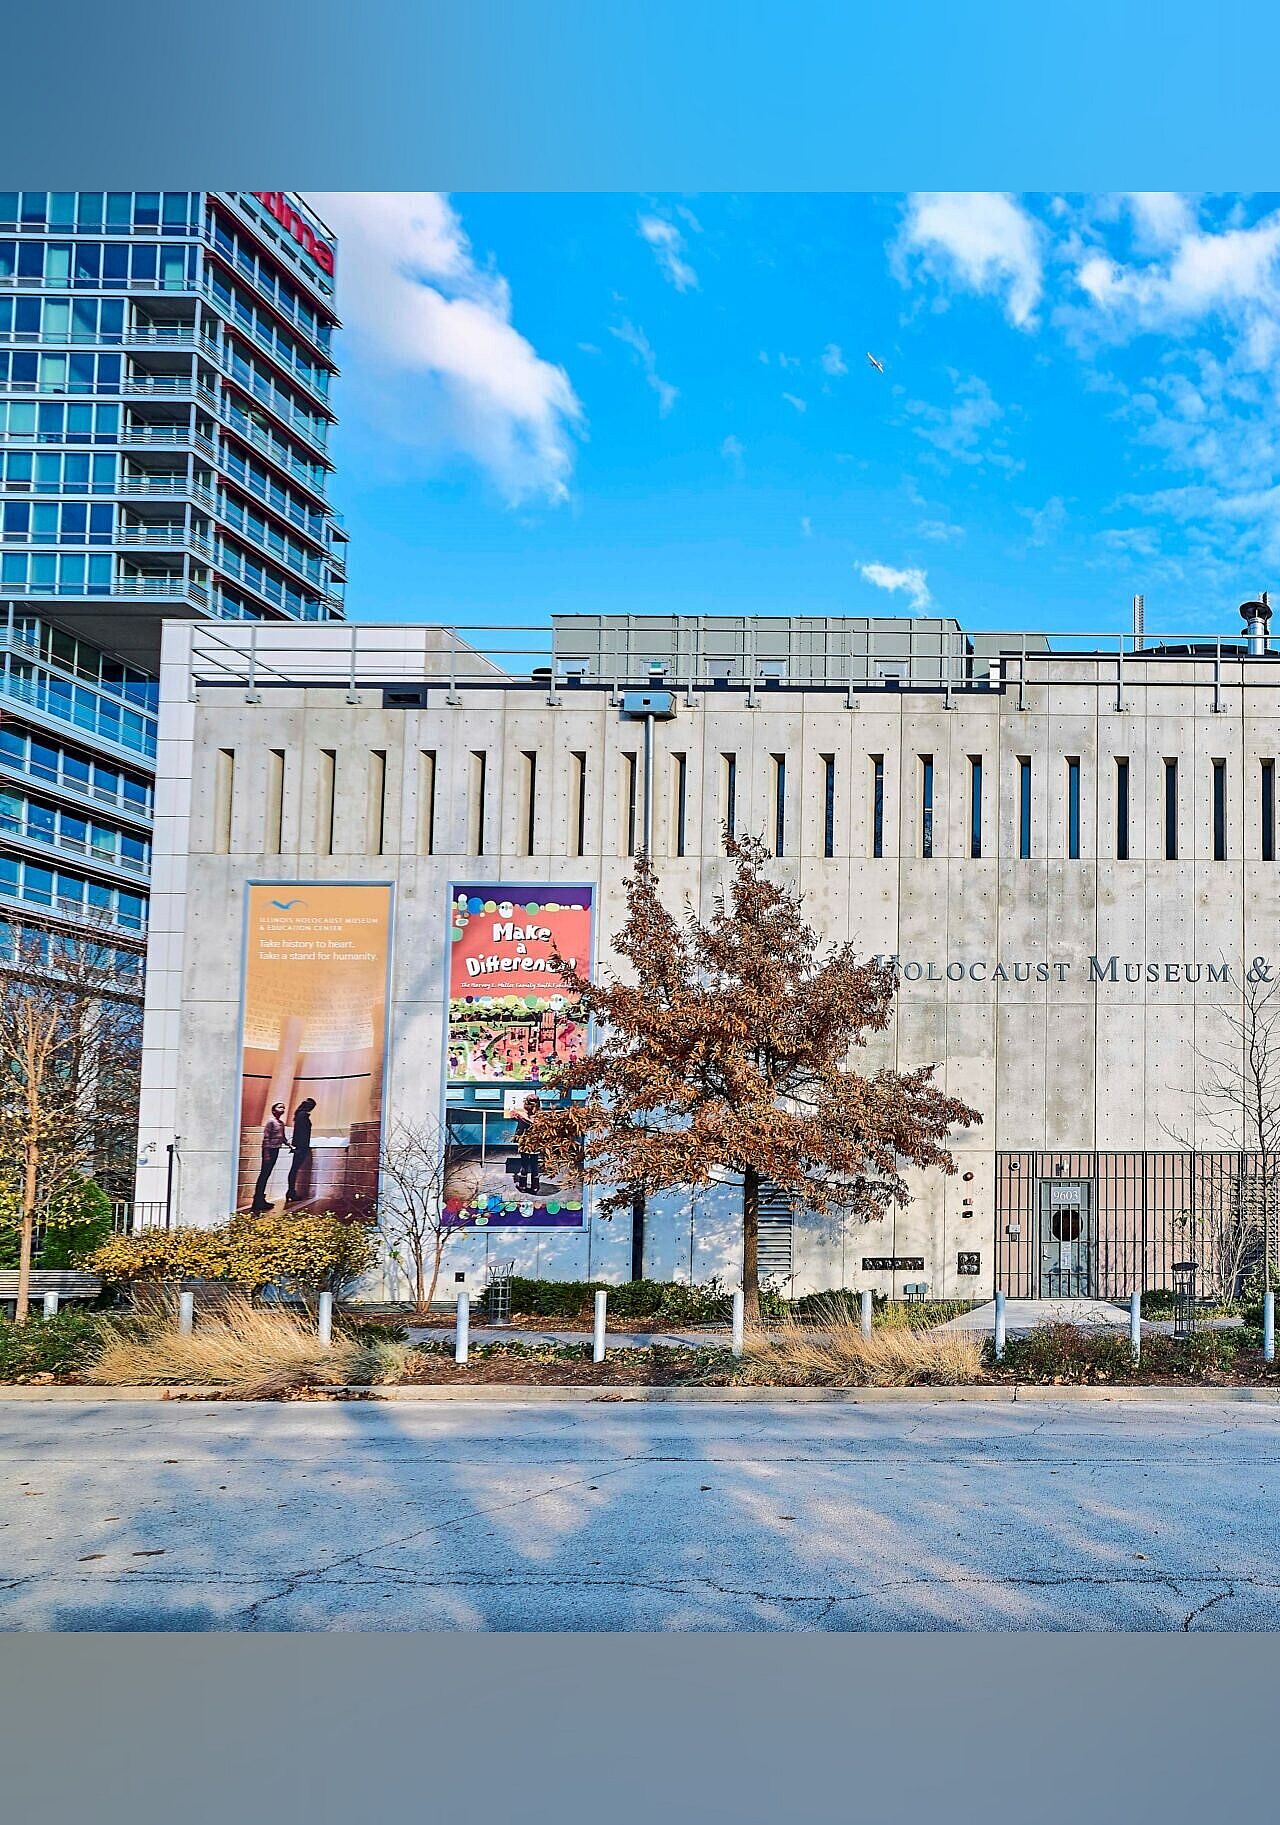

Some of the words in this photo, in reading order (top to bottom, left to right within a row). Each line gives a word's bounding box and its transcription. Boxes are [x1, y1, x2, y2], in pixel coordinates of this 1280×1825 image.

[492, 922, 553, 942] Make
[259, 939, 280, 948] Take
[281, 939, 313, 950] history
[316, 940, 326, 948] to
[516, 942, 528, 954] a
[259, 951, 280, 960] Take
[289, 951, 316, 960] stand
[318, 951, 331, 960] for
[332, 951, 378, 962] humanity.
[1087, 955, 1231, 983] MUSEUM
[1245, 956, 1275, 984] &
[1053, 1190, 1078, 1199] 9603
